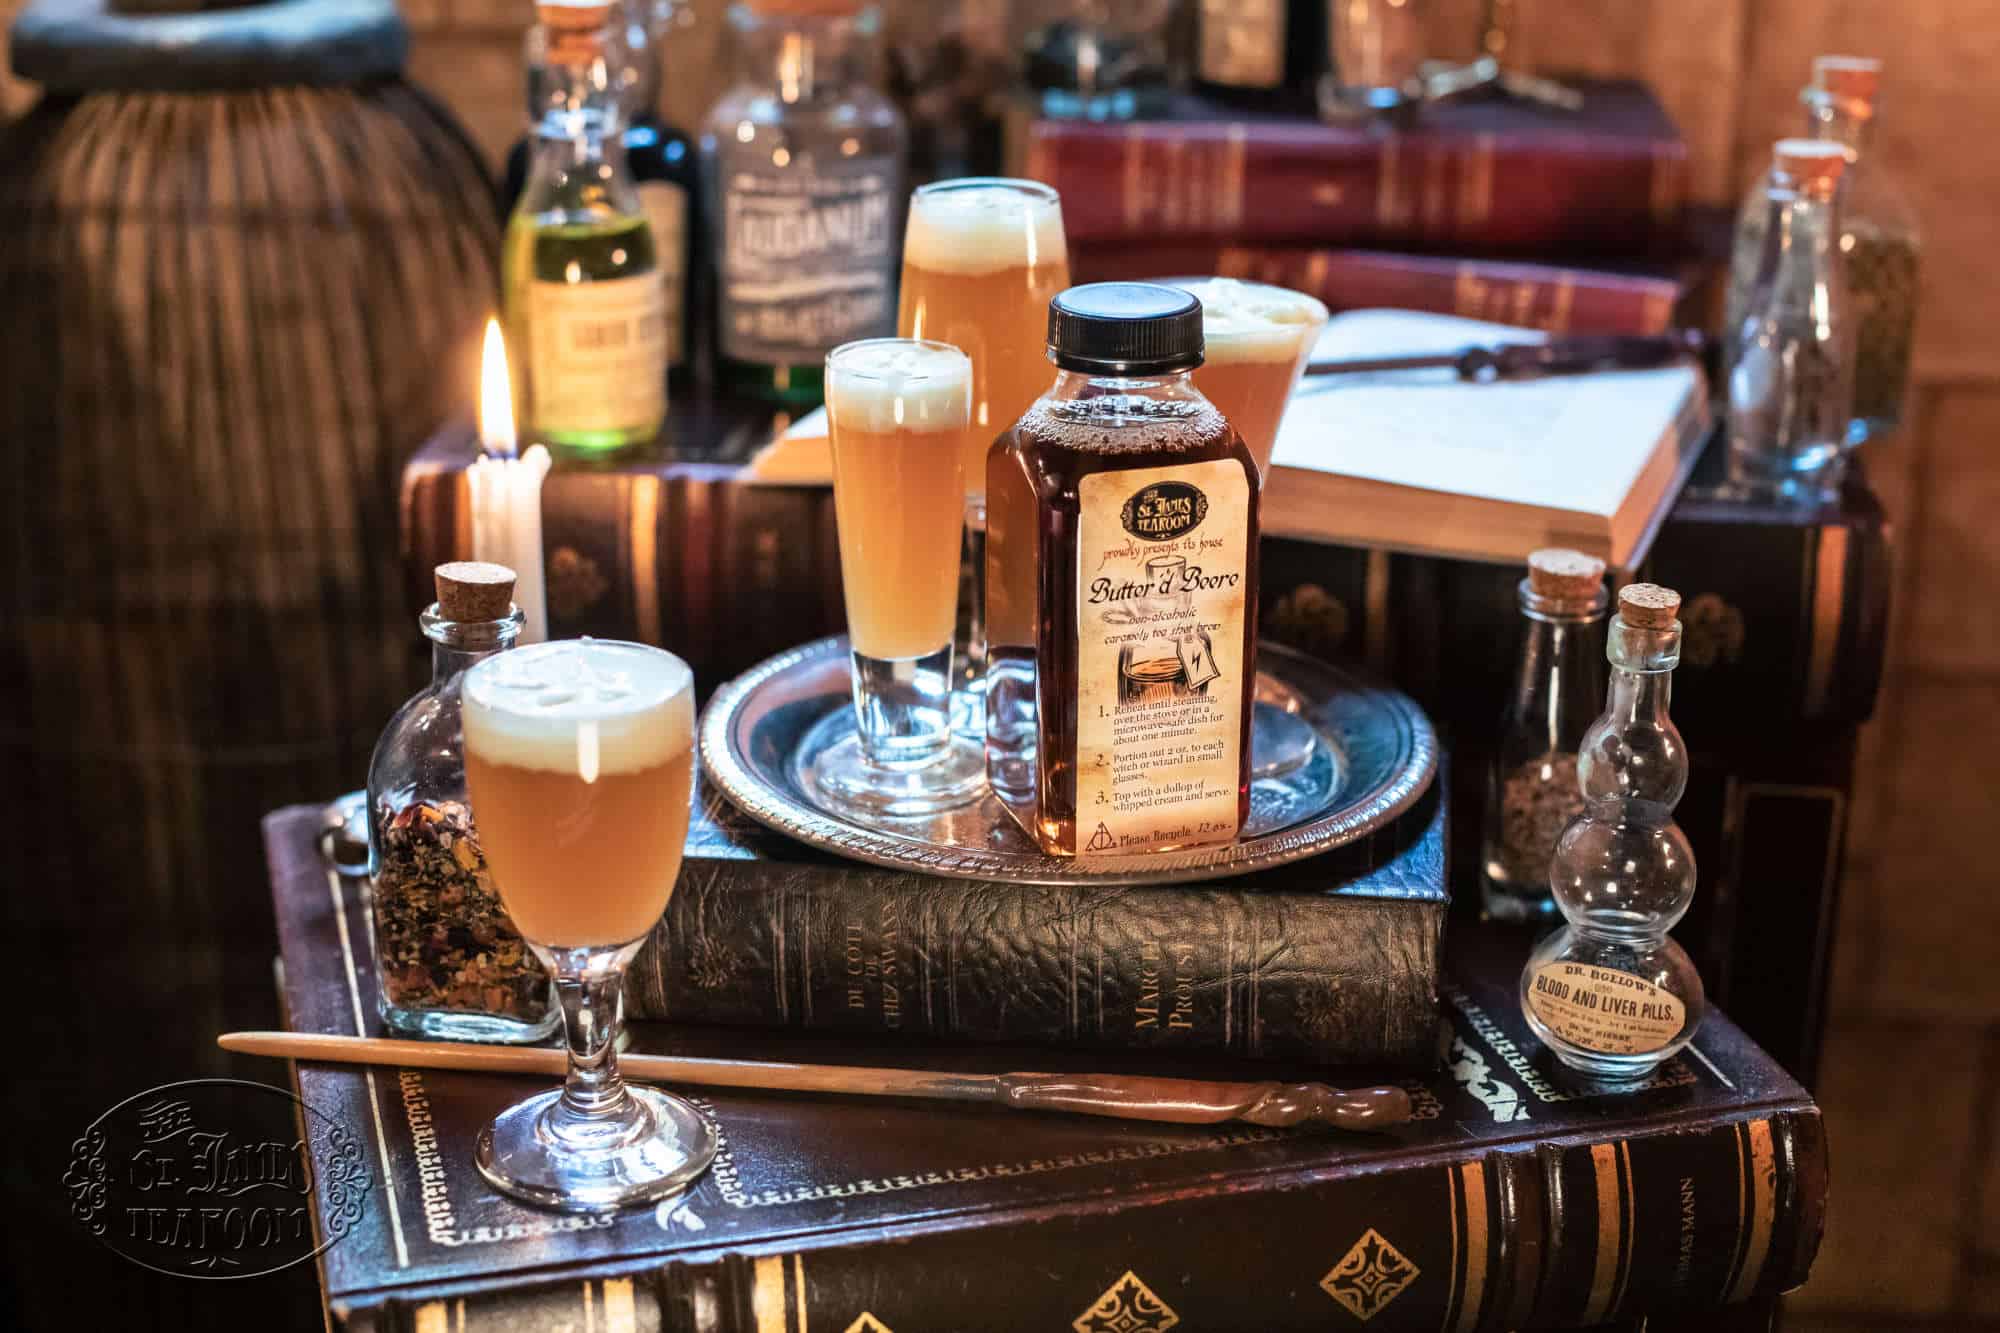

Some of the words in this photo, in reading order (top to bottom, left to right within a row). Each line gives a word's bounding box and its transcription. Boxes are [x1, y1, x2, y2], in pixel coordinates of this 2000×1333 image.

[1137, 514, 1191, 532] TEAROOM
[1098, 538, 1140, 571] proudly
[1137, 542, 1179, 567] presents
[1099, 705, 1110, 718] 1.
[1114, 702, 1146, 715] Reheat
[1148, 699, 1171, 710] until
[1113, 717, 1135, 726] over
[1136, 711, 1151, 721] the
[1152, 709, 1178, 719] stove
[1179, 707, 1191, 715] or
[1192, 705, 1202, 714] in
[1187, 713, 1208, 725] dish
[1210, 712, 1224, 722] for
[1113, 734, 1140, 746] about
[1141, 732, 1159, 741] one
[1095, 753, 1110, 767] 2.
[1113, 752, 1148, 763] Portion
[1149, 747, 1165, 758] out
[1191, 743, 1201, 752] to
[1203, 739, 1224, 751] each
[1112, 762, 1138, 774] witch
[1140, 760, 1150, 769] or
[1152, 755, 1184, 767] wizard
[1185, 753, 1195, 762] in
[1197, 750, 1223, 762] small
[1095, 789, 1109, 804] 3.
[1113, 791, 1131, 802] Top
[1133, 786, 1153, 798] with
[1163, 780, 1193, 794] dollop
[1194, 777, 1205, 789] of
[1113, 796, 1153, 812] whipped
[1154, 794, 1183, 805] cream
[1185, 789, 1203, 801] and
[1537, 975, 1570, 1000] BLOOD
[1571, 988, 1598, 1009] AND
[1601, 996, 1637, 1018] LIVER
[1641, 1002, 1674, 1021] PILLS.
[1679, 1176, 1696, 1232] MANN
